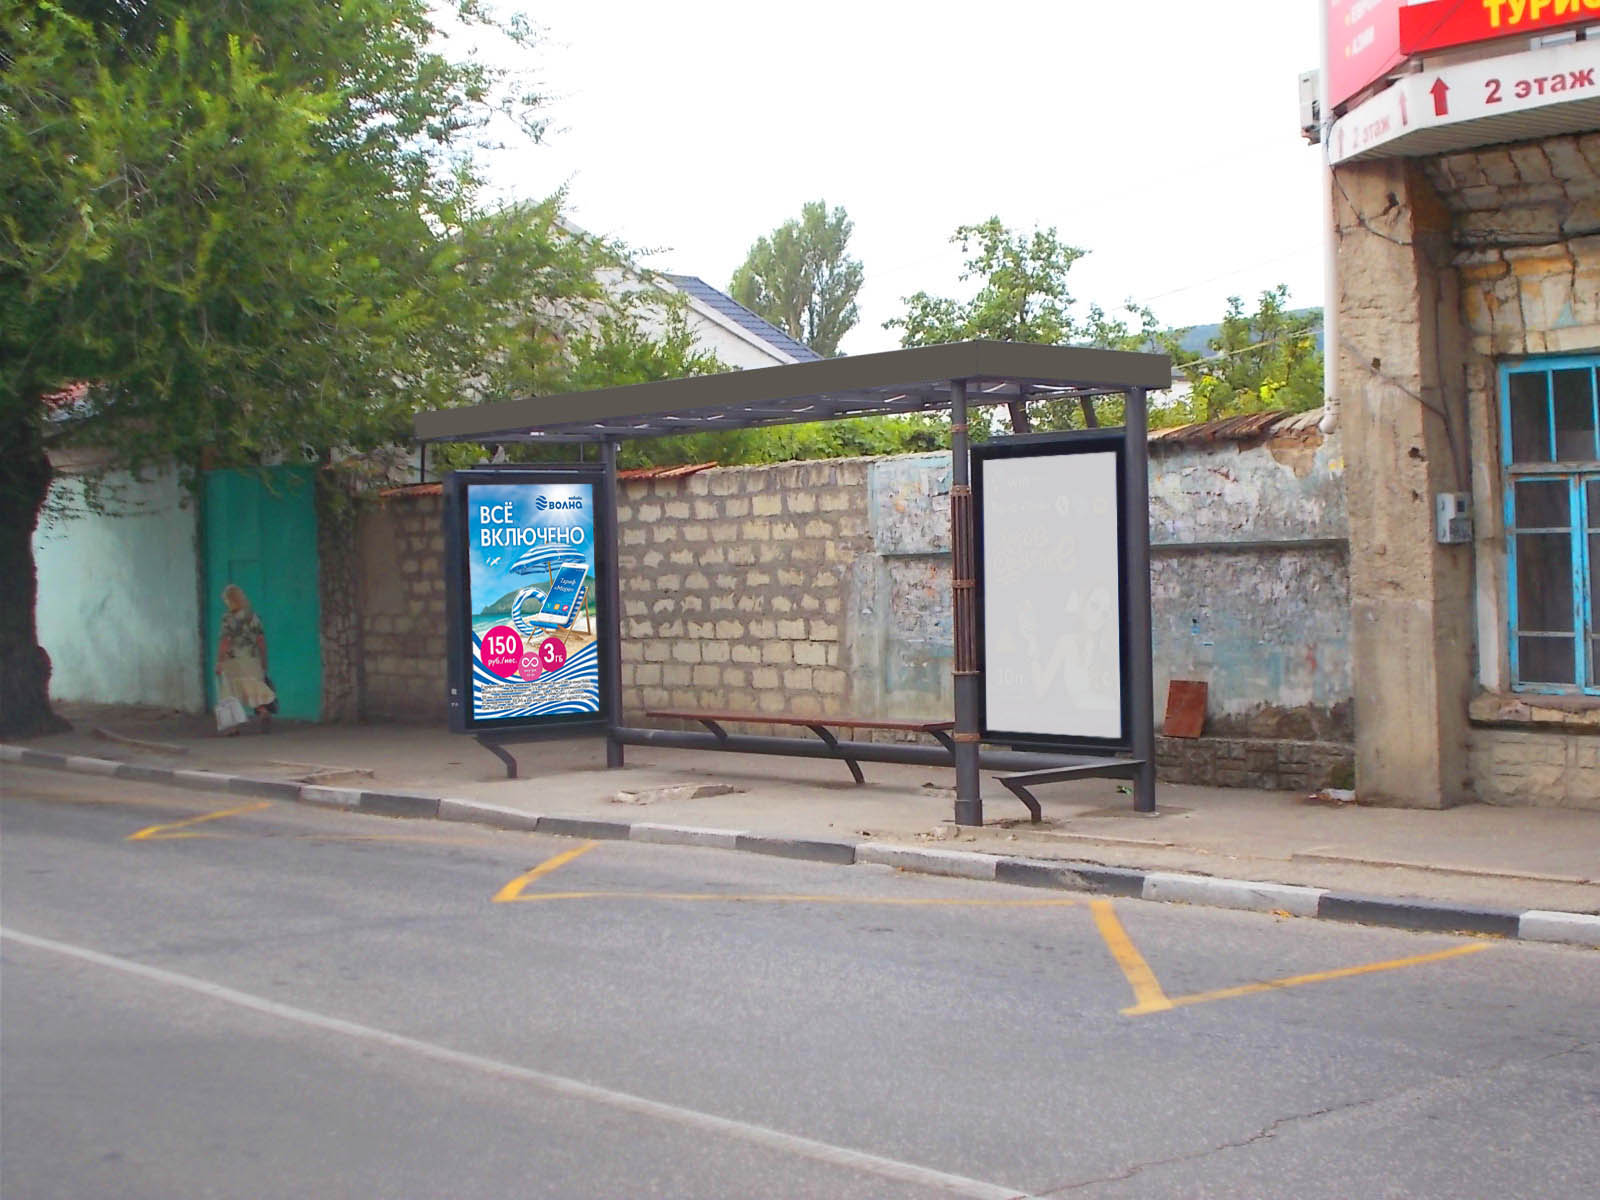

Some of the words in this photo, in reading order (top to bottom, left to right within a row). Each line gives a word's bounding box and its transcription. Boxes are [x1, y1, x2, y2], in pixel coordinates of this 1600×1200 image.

[1483, 0, 1600, 28] ТУРИ
[1485, 78, 1503, 104] 2
[1514, 67, 1595, 99] этаж
[480, 501, 514, 524] ВСЁ
[480, 526, 585, 547] ВКЛЮЧЕНО
[488, 635, 516, 655] 150
[543, 643, 555, 663] 3
